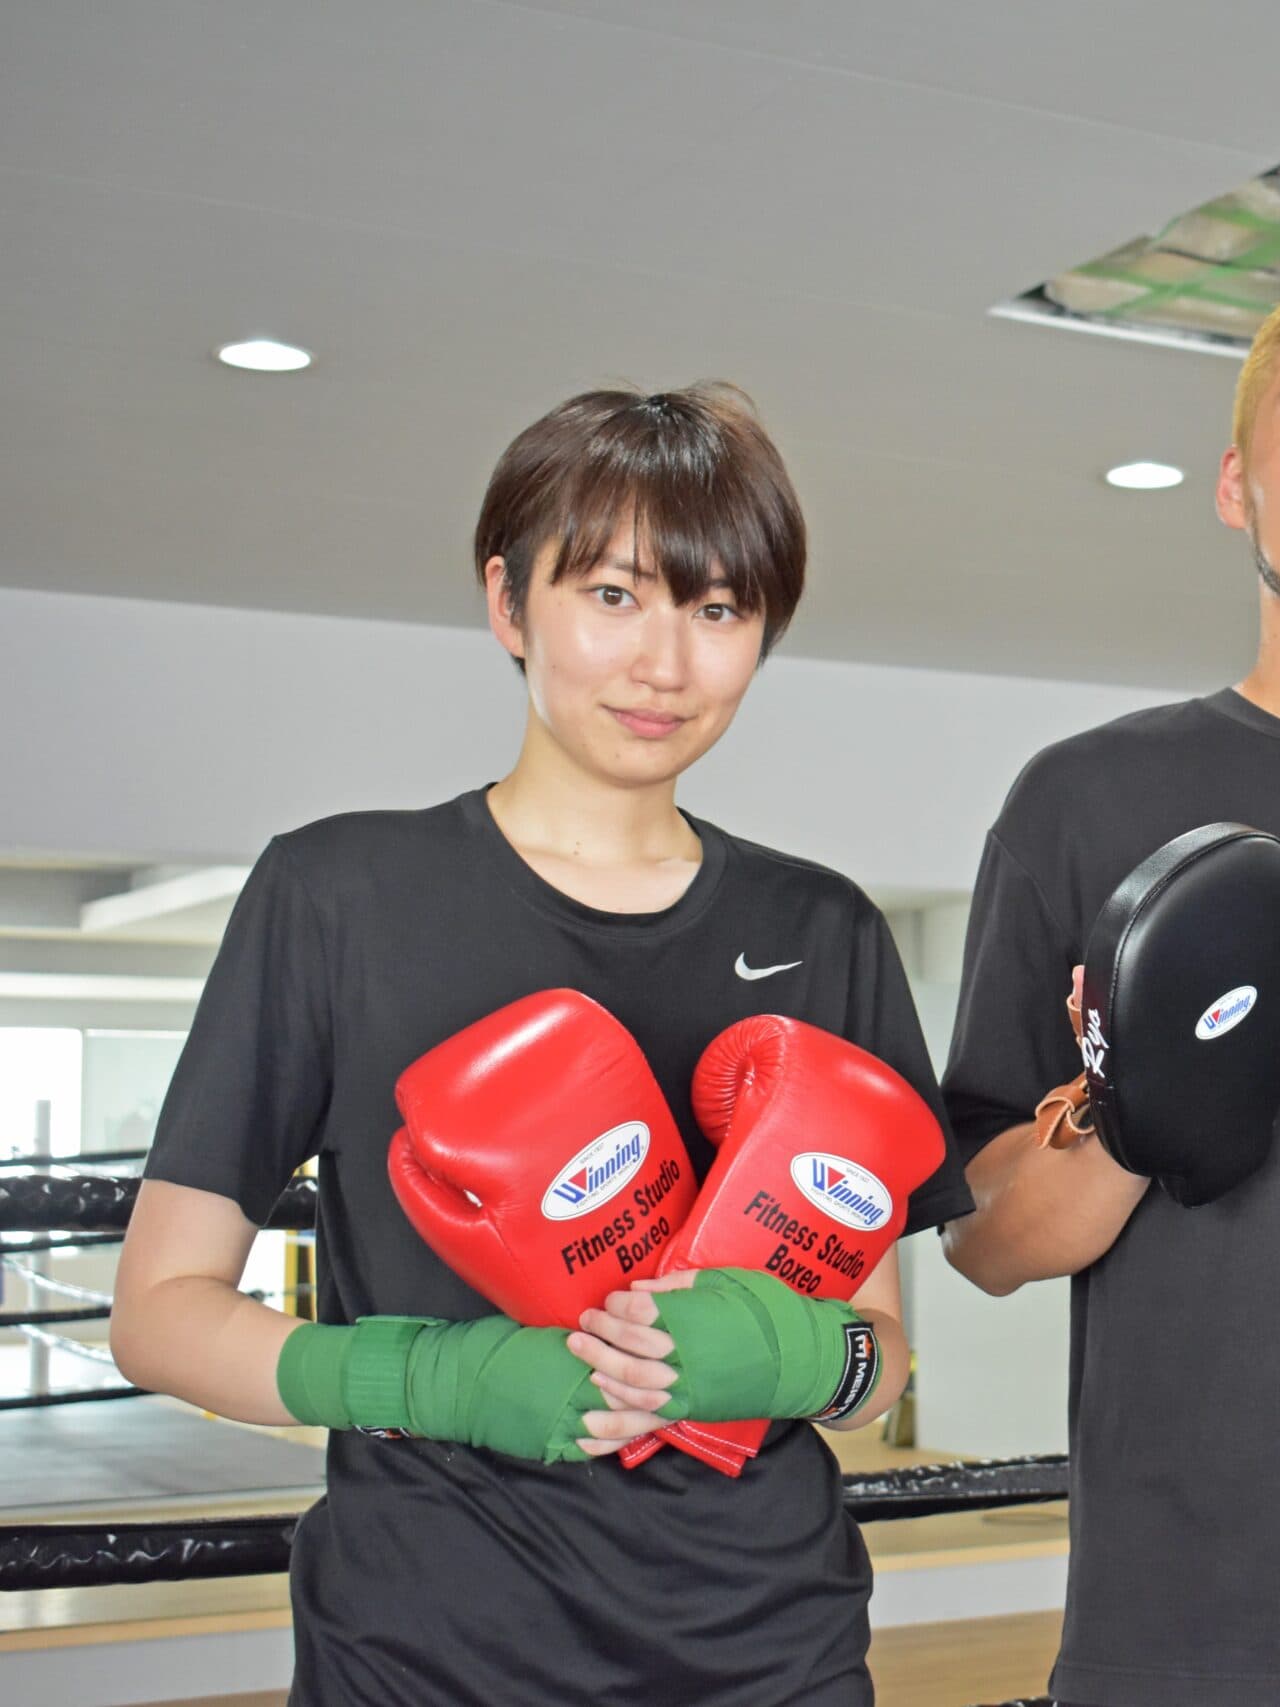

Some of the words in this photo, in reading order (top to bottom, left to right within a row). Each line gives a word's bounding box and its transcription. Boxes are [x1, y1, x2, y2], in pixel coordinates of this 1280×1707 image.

[1203, 995, 1251, 1030] Winning
[553, 1134, 641, 1204] Winning
[812, 1158, 884, 1226] Winning
[561, 1209, 635, 1275] Fitness
[634, 1159, 680, 1217] Studio
[616, 1216, 670, 1274] Boxeo
[743, 1190, 819, 1251] Fitness
[817, 1234, 865, 1280] Studio
[765, 1243, 821, 1294] Boxeo
